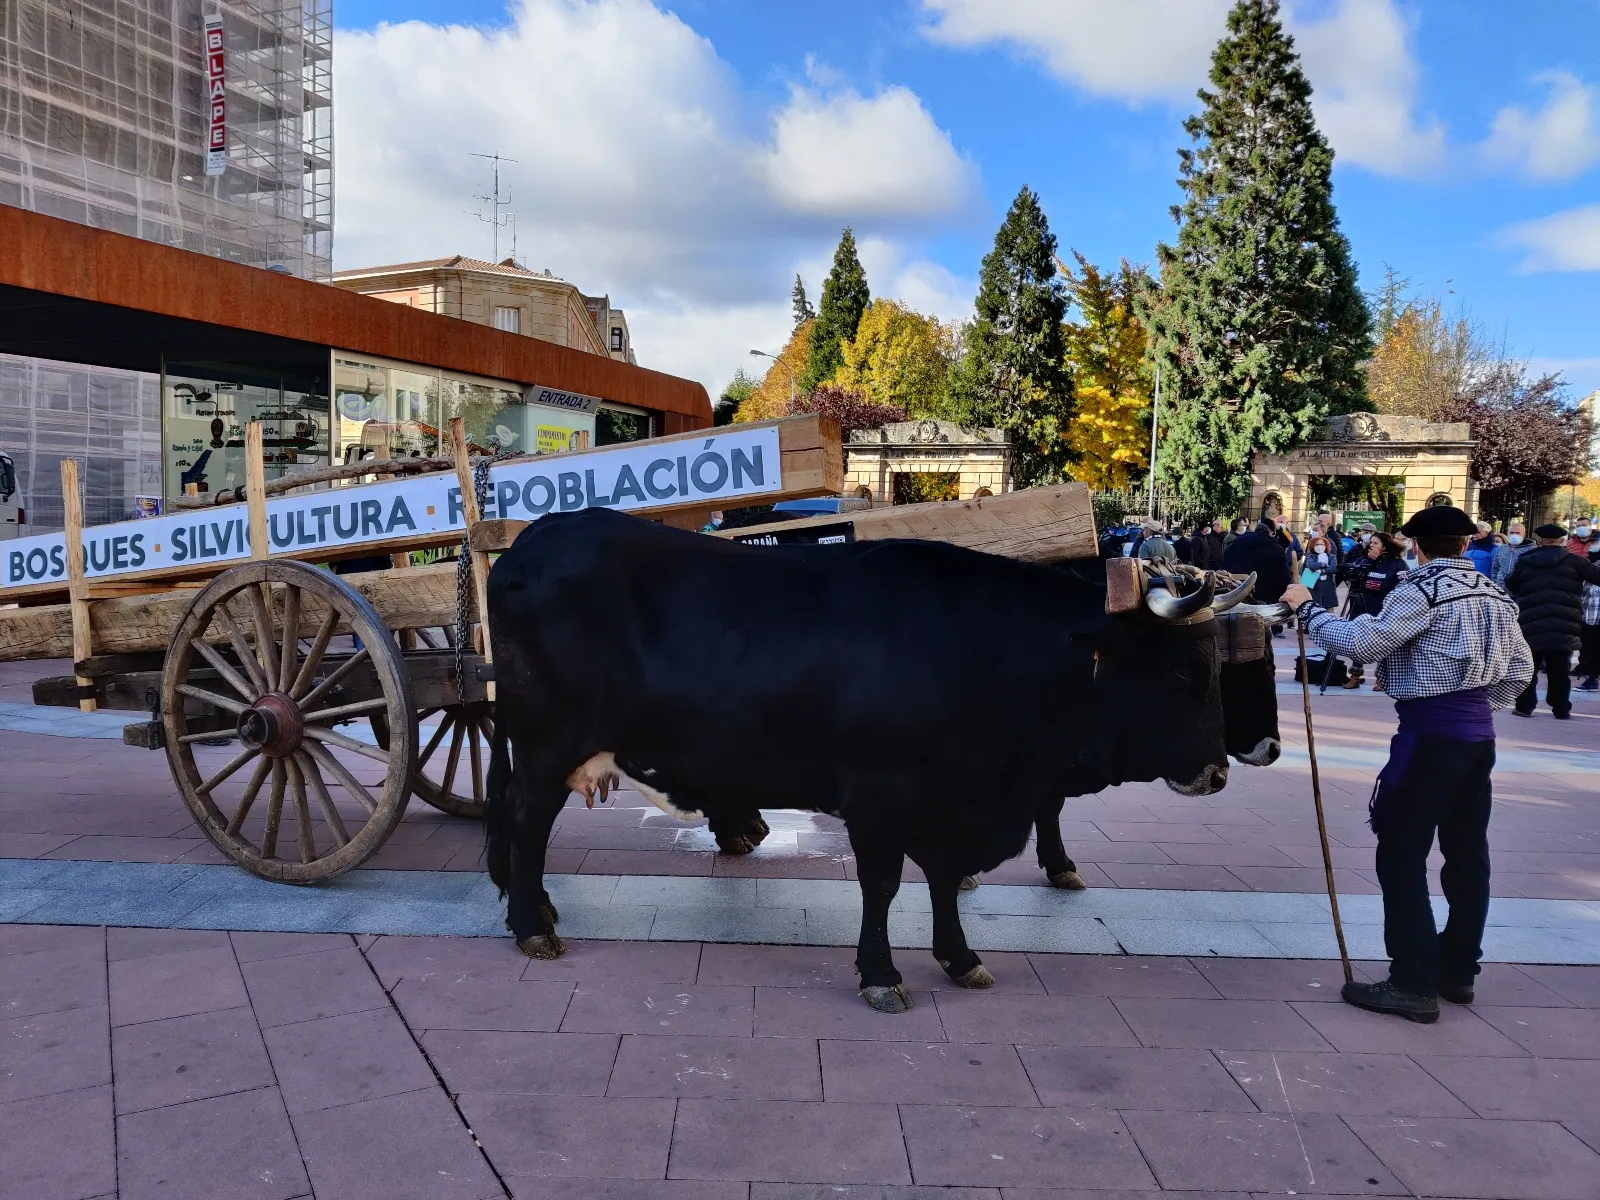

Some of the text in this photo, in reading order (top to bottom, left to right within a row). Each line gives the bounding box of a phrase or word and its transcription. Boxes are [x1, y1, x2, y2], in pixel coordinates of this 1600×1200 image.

[208, 33, 225, 144] BLAPE
[538, 390, 592, 410] ENTRADA 2
[1299, 450, 1346, 459] ALAMEDA
[9, 533, 146, 583] BOSUES
[170, 495, 418, 562] SILVIULTURA
